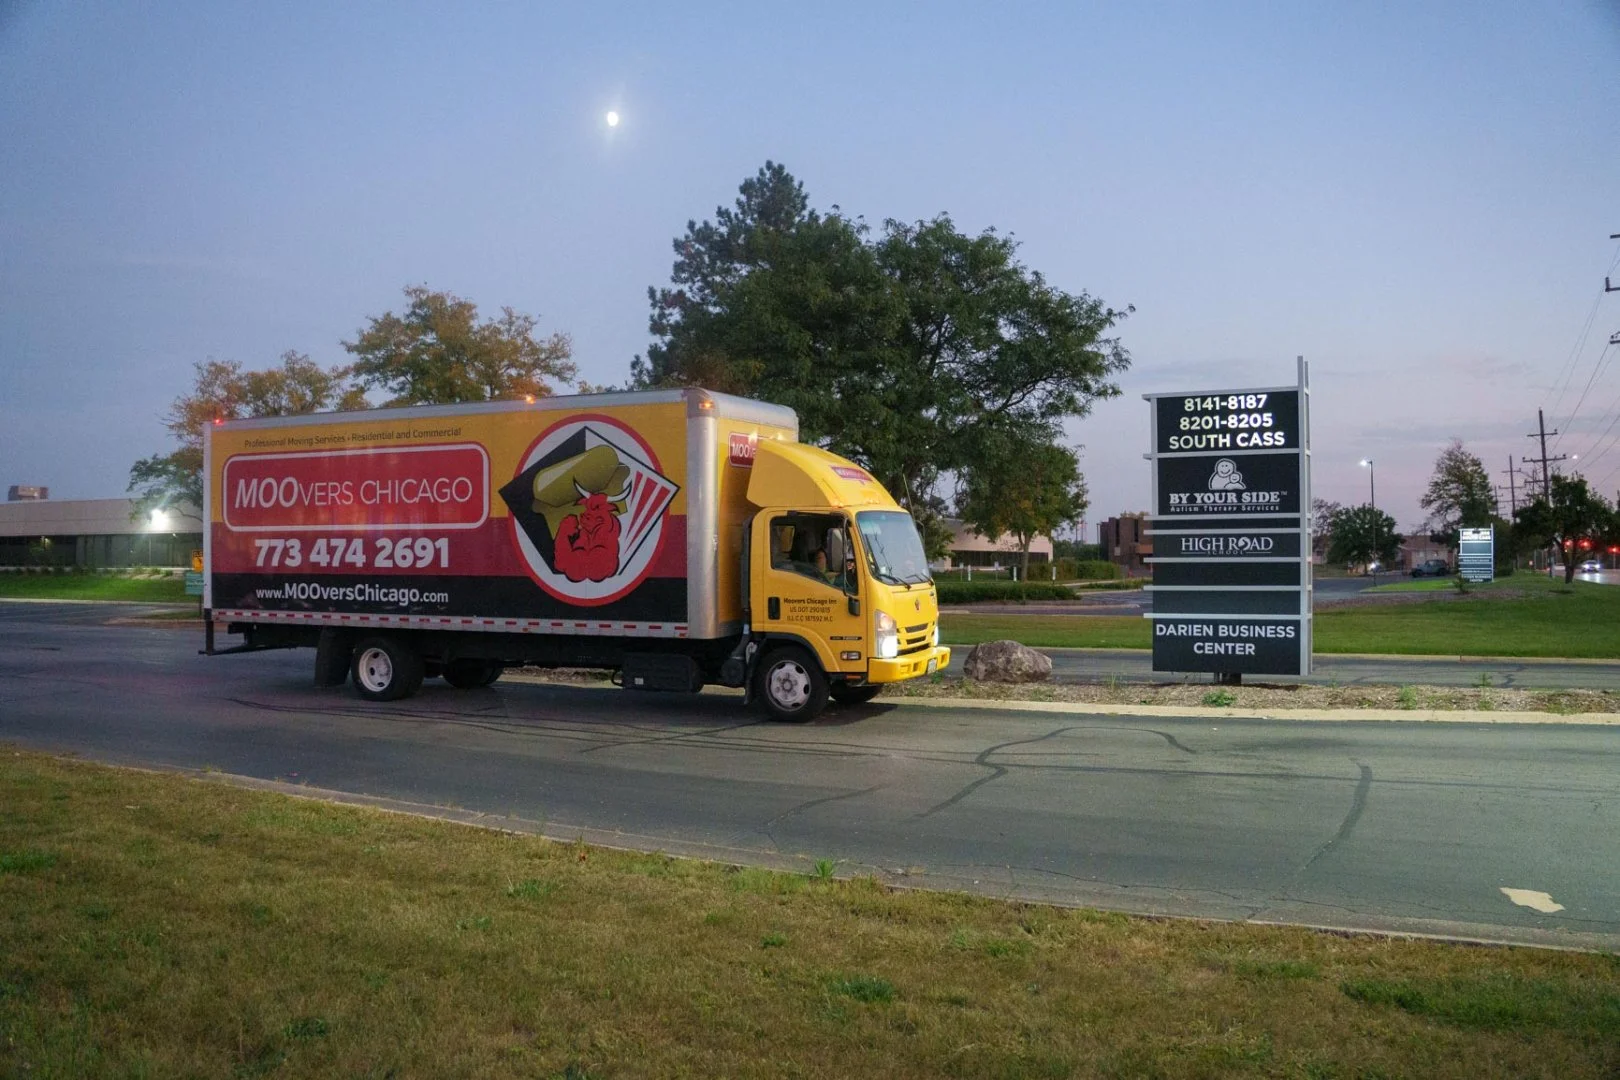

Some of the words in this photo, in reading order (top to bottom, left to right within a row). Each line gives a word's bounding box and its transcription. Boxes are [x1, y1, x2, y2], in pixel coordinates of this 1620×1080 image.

[1184, 394, 1268, 412] 8141-8187
[1179, 413, 1273, 431] 8201-8205
[244, 438, 286, 448] Professional
[287, 437, 313, 447] Moving
[314, 435, 345, 445] Services
[351, 431, 394, 442] Residential
[395, 428, 411, 439] and
[413, 427, 462, 438] Commercial
[1169, 433, 1231, 449] SOUTH
[1236, 431, 1285, 447] CASS
[234, 476, 354, 509] MOOVERS
[360, 476, 473, 505] CHICAGO
[1169, 492, 1190, 504] BY
[1194, 491, 1238, 504] YOUR
[1241, 491, 1280, 503] SIDE
[1170, 505, 1199, 513] Autism
[1203, 505, 1237, 513] Therapy
[1241, 504, 1280, 512] Services
[254, 538, 302, 567] 773
[309, 538, 366, 567] 474
[374, 537, 449, 568] 2691
[1181, 537, 1224, 551] HIGH
[1228, 536, 1274, 551] ROAD
[255, 582, 449, 606] www.MOOversChicago.com
[806, 597, 828, 606] Chicago
[1156, 624, 1213, 637] DARIEN
[1218, 625, 1296, 638] BUSINESS
[1193, 642, 1256, 655] CENTER
